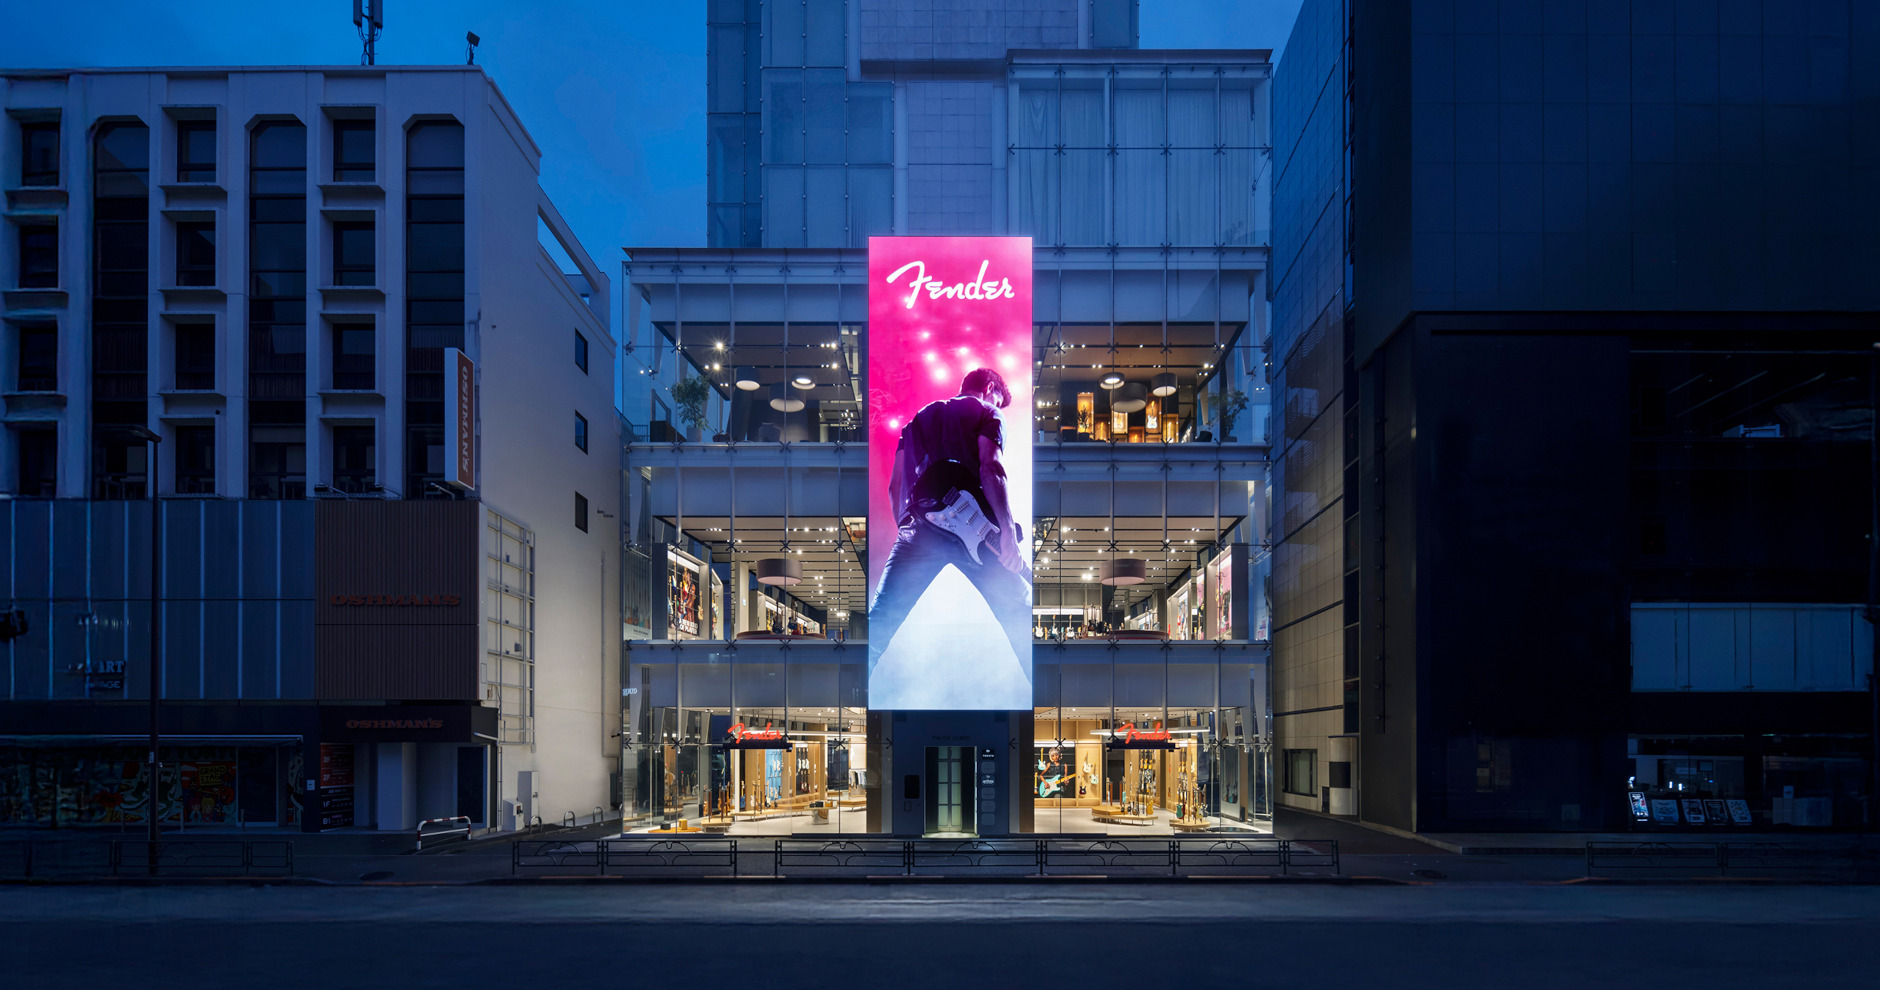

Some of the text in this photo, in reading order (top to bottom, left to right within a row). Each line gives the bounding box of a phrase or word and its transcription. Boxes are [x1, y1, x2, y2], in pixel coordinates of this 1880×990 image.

[886, 259, 1015, 309] Fender
[461, 365, 470, 473] OSHMAN'S
[330, 593, 461, 607] OSHMAN'S
[346, 717, 443, 729] OSHMAN'S
[727, 722, 782, 744] Fender
[1117, 722, 1172, 744] Fender
